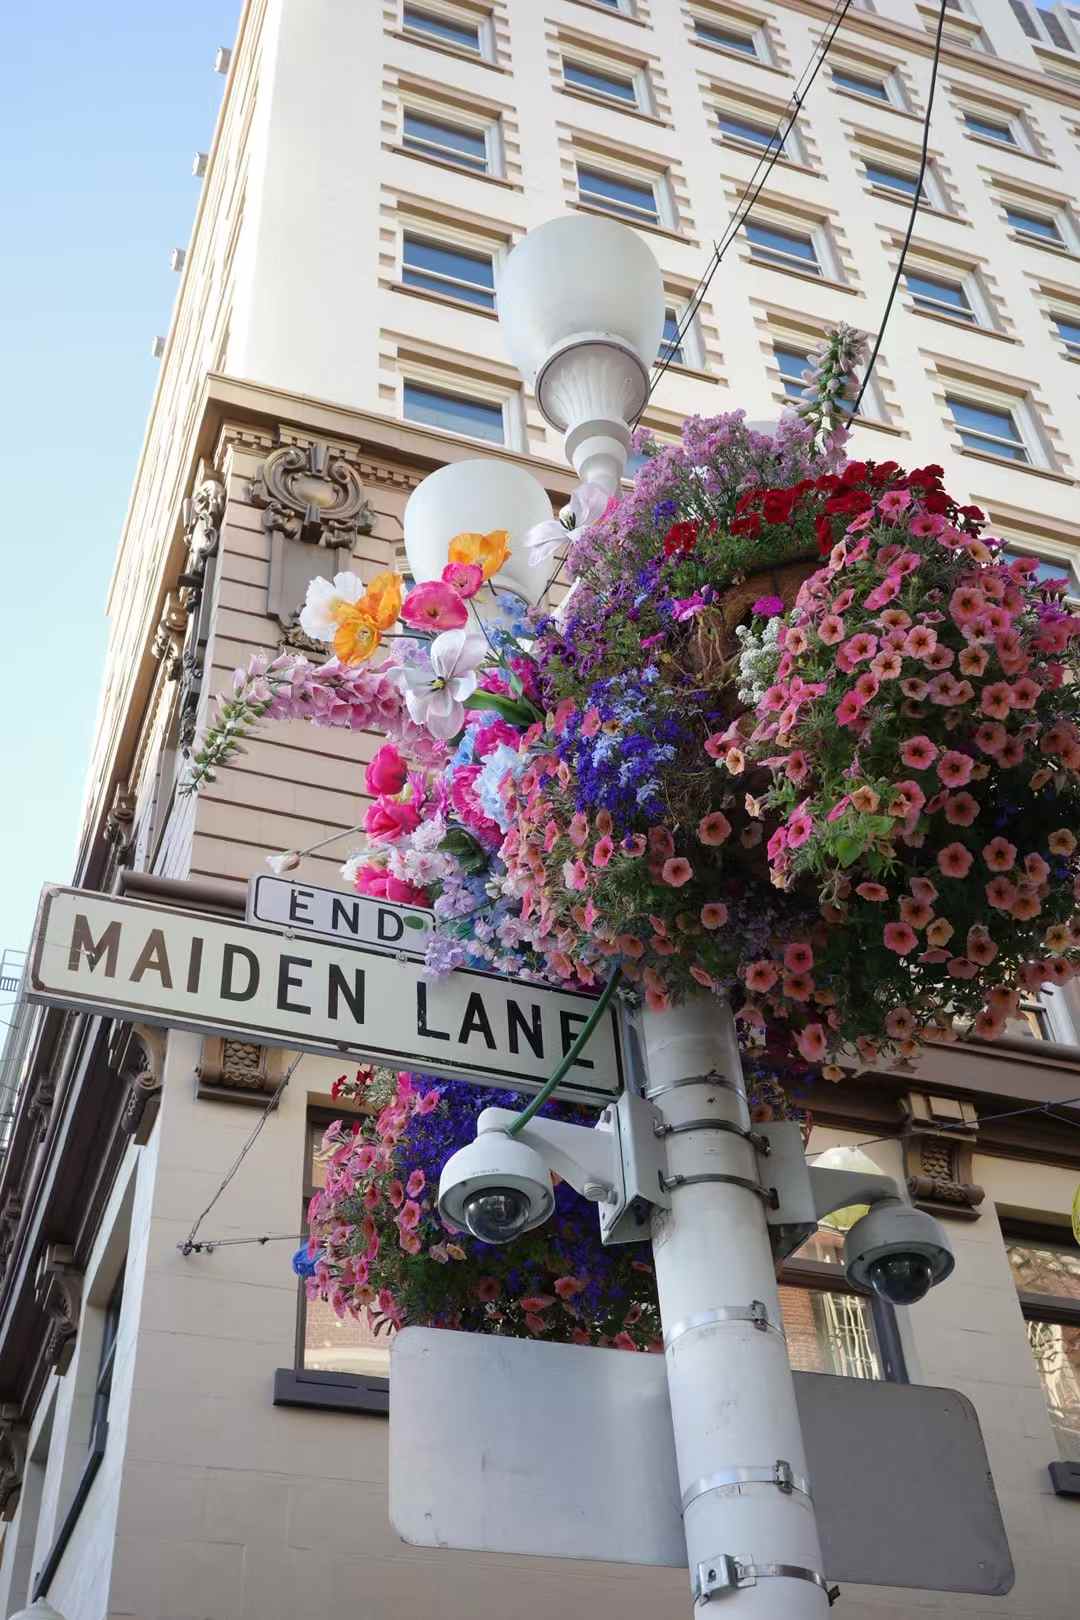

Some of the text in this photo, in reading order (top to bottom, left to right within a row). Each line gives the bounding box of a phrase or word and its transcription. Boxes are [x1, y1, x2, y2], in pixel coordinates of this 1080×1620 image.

[289, 888, 404, 942] END
[67, 914, 594, 1069] MAIDEN LANE
